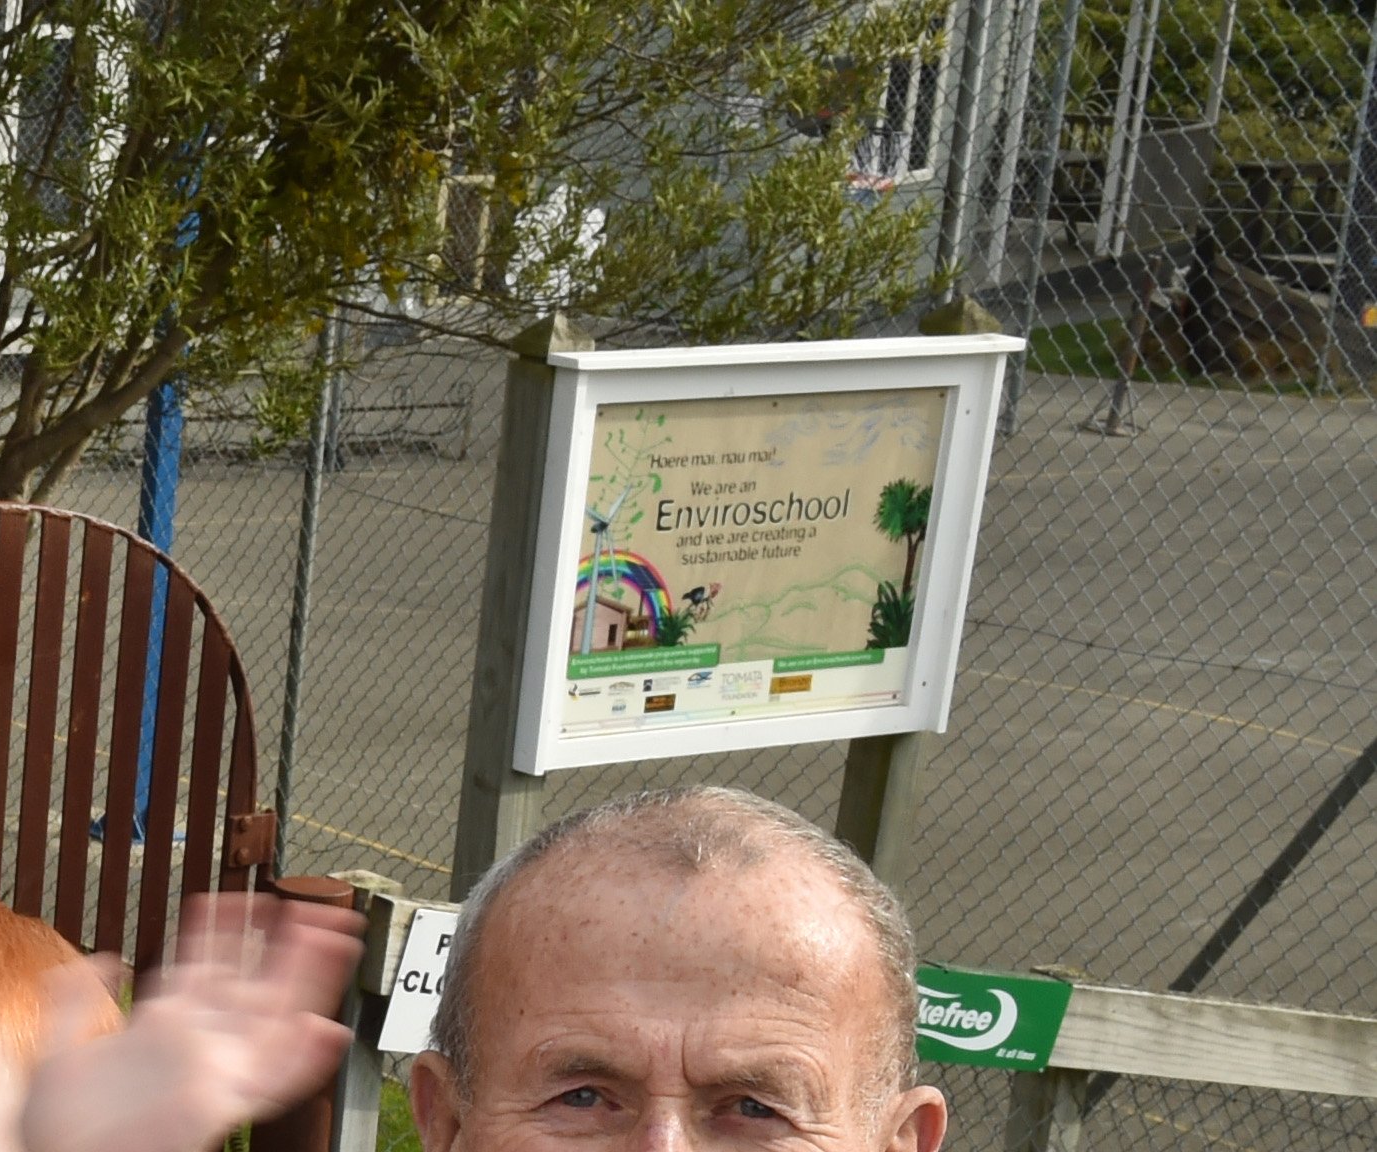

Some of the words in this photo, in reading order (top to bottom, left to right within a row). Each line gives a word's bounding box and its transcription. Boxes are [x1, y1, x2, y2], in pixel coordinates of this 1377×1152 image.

[721, 452, 745, 464] nau
[691, 481, 712, 496] We
[715, 482, 736, 495] are
[739, 481, 756, 493] an
[656, 488, 850, 531] Enviroschool
[676, 532, 703, 547] and
[706, 533, 724, 545] we
[727, 531, 748, 544] are
[751, 527, 806, 543] creating
[808, 526, 817, 538] a
[681, 547, 758, 565] sustainable
[762, 544, 801, 559] future
[918, 998, 993, 1031] kefree
